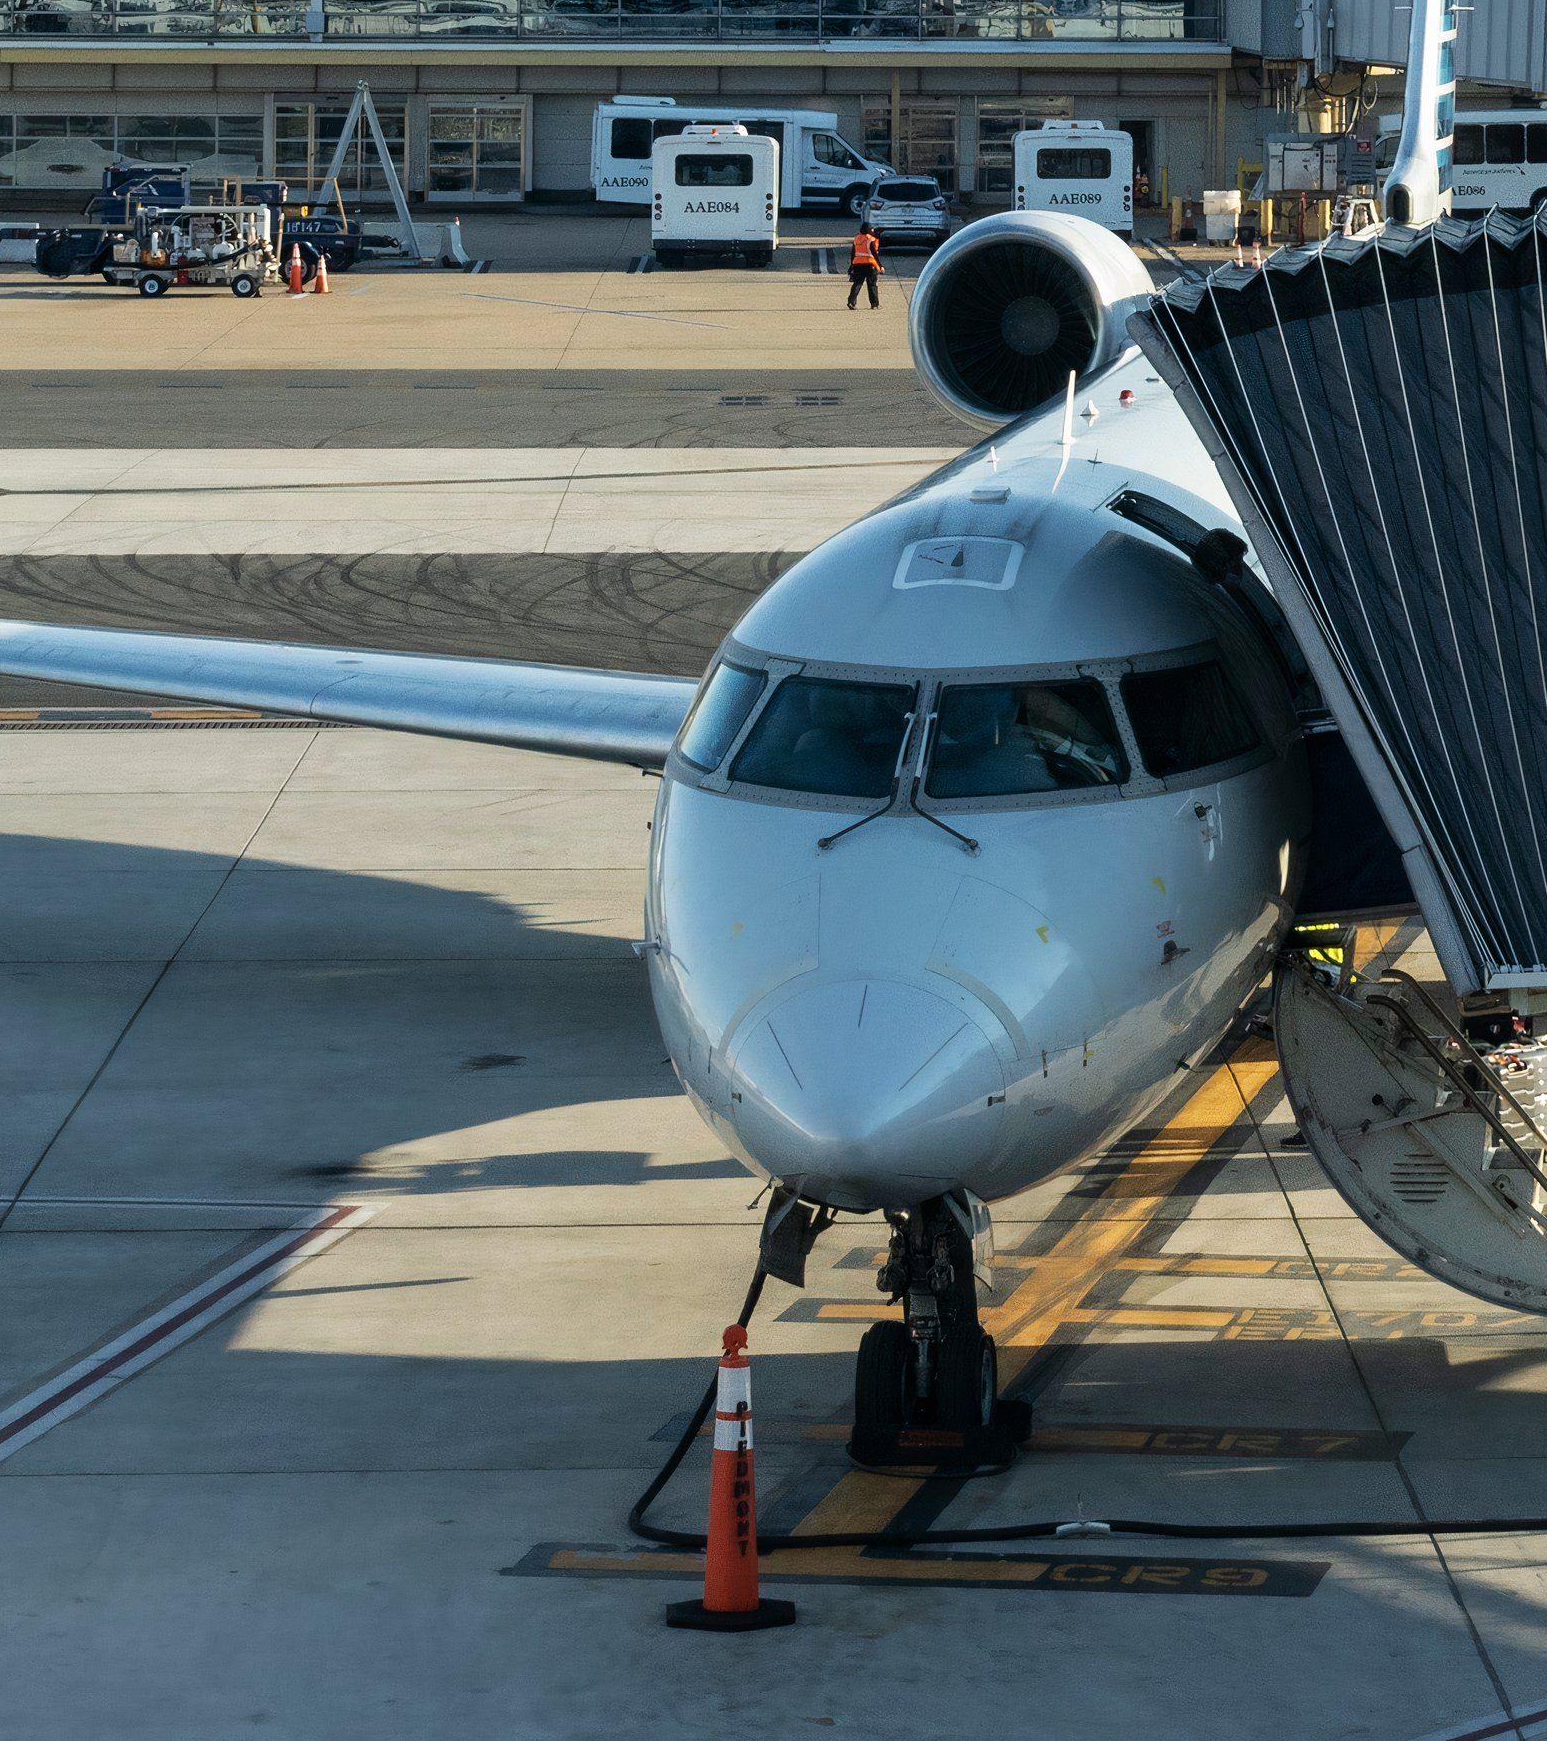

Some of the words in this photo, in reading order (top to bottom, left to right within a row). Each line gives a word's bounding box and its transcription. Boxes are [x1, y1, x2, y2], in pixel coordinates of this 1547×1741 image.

[601, 177, 649, 187] AAE090
[1049, 193, 1102, 204] AAE089
[684, 201, 740, 213] AAE084
[1150, 1431, 1358, 1454] CR7
[1048, 1562, 1270, 1587] CR9
